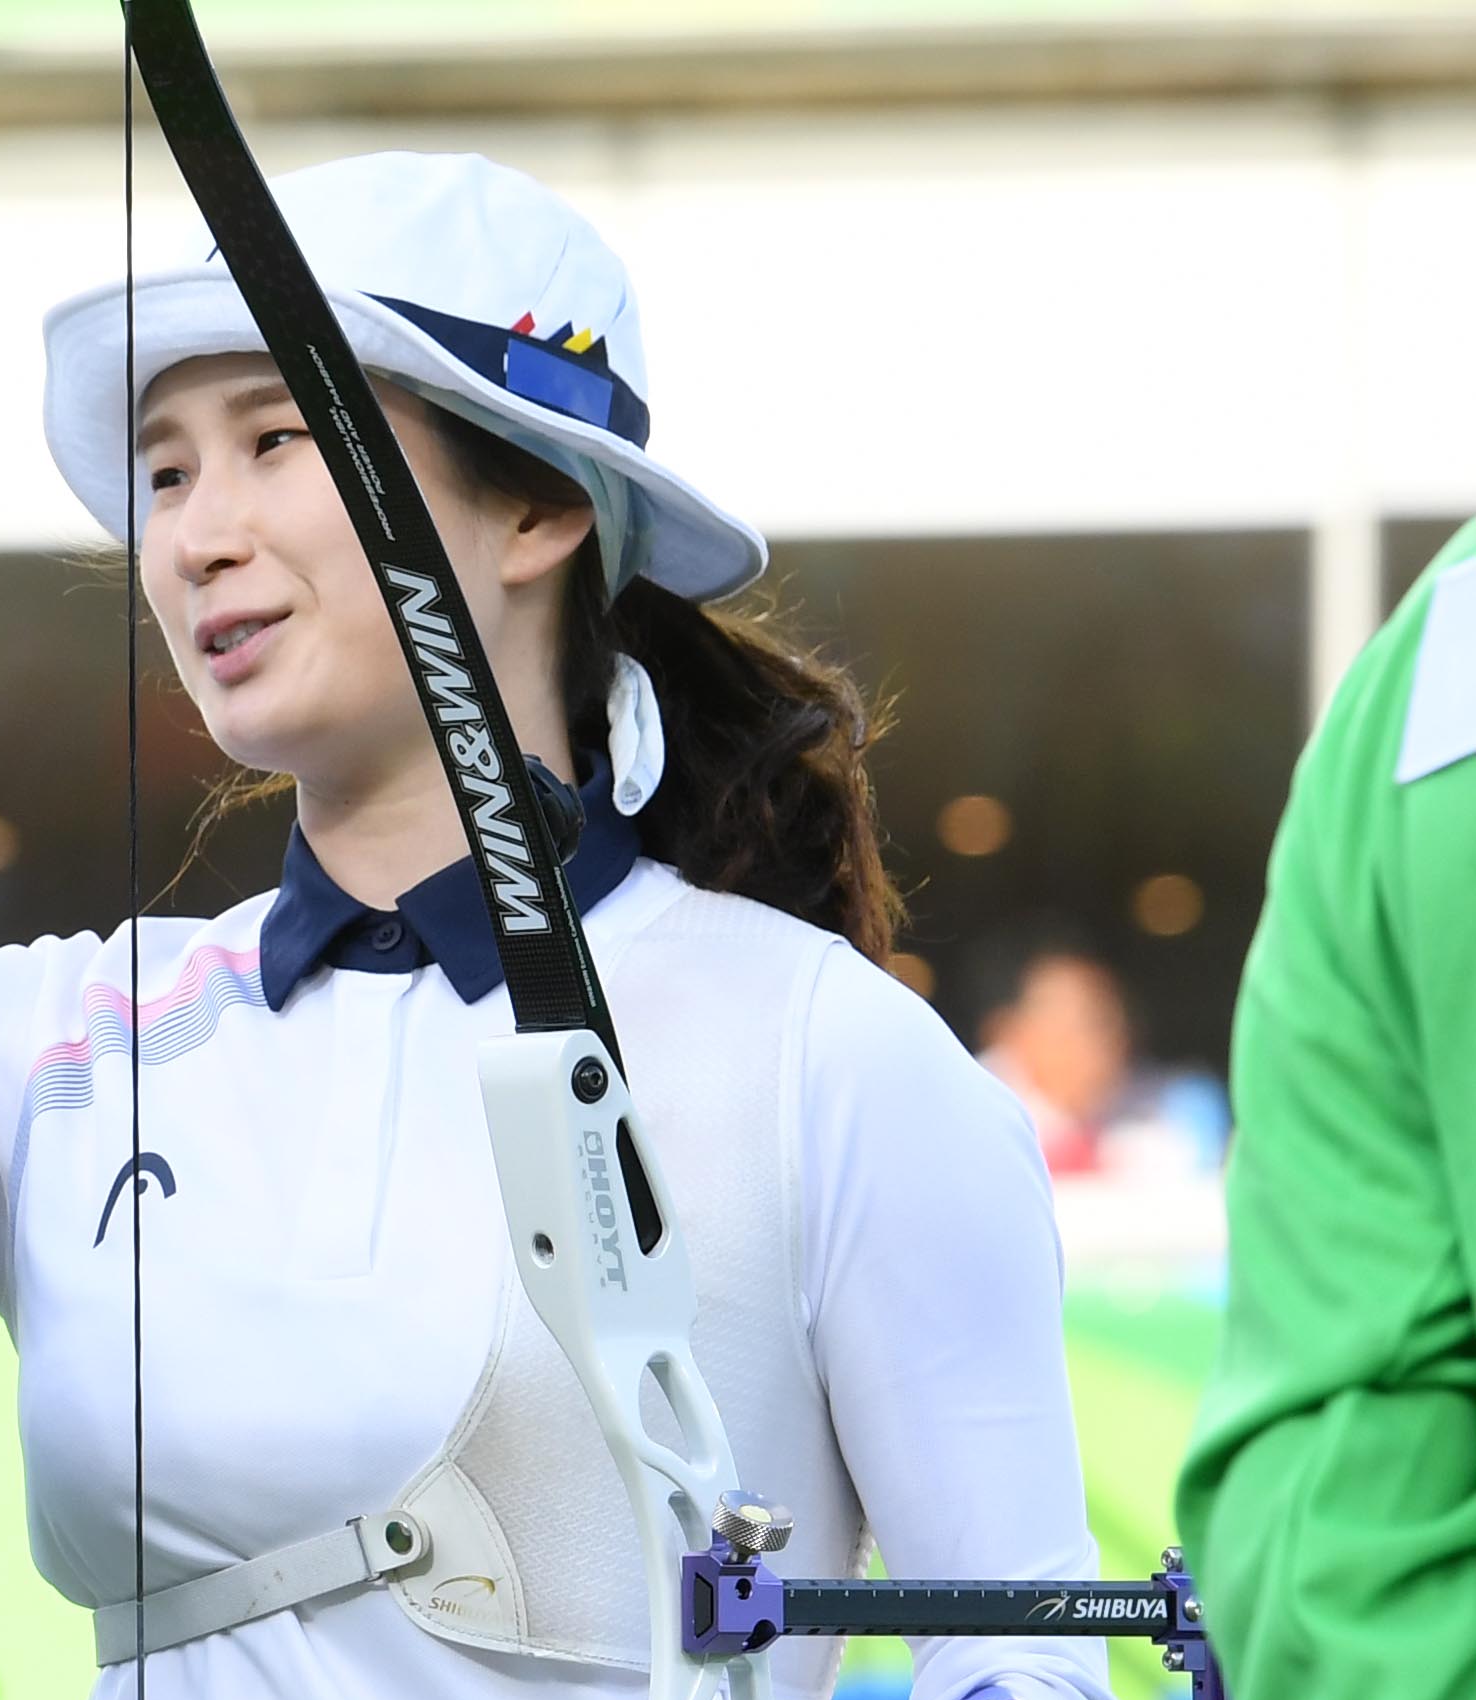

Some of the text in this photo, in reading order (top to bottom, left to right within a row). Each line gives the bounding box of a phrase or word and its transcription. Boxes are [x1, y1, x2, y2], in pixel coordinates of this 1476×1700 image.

[306, 344, 386, 495] POWER AND PASSION
[329, 406, 396, 541] PROFESSIONALISM,
[379, 562, 552, 936] WIN&WIN
[588, 1157, 628, 1292] HOYT
[1072, 1597, 1169, 1619] SHIBUYA
